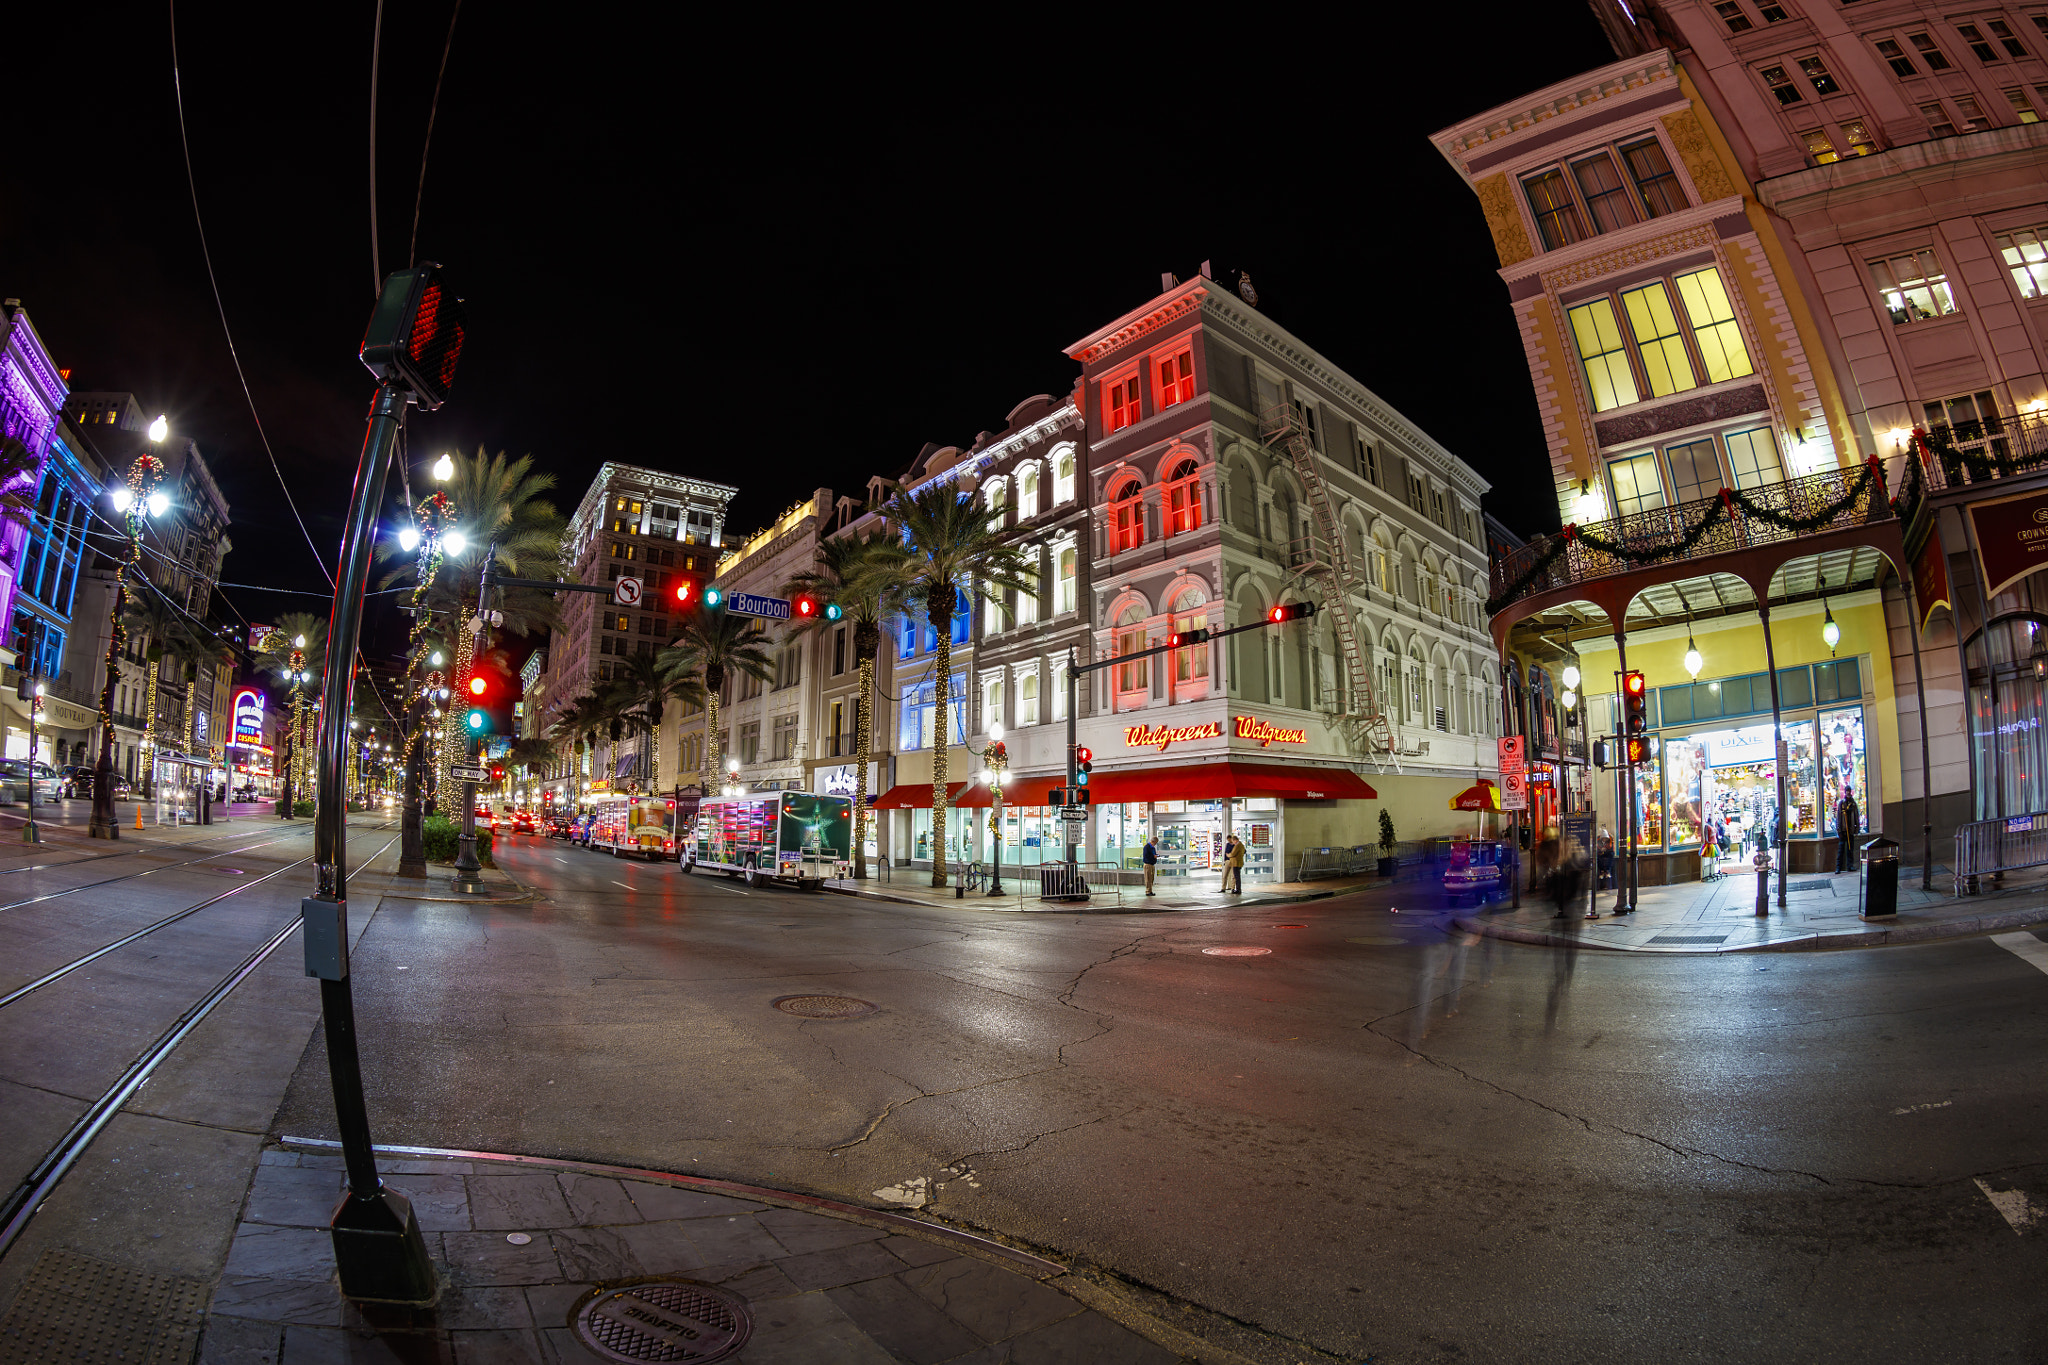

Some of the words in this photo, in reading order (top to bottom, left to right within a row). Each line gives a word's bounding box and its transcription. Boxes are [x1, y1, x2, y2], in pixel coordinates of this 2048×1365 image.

[2017, 526, 2048, 541] CROWNE
[738, 594, 788, 617] Bourbon
[54, 704, 86, 723] NOUVEAU
[236, 726, 255, 735] PHOTO
[1123, 721, 1220, 751] Walgreens
[1237, 716, 1307, 748] Walgreens
[1720, 734, 1763, 747] DIXIE
[624, 1306, 700, 1340] TRAFFIC
